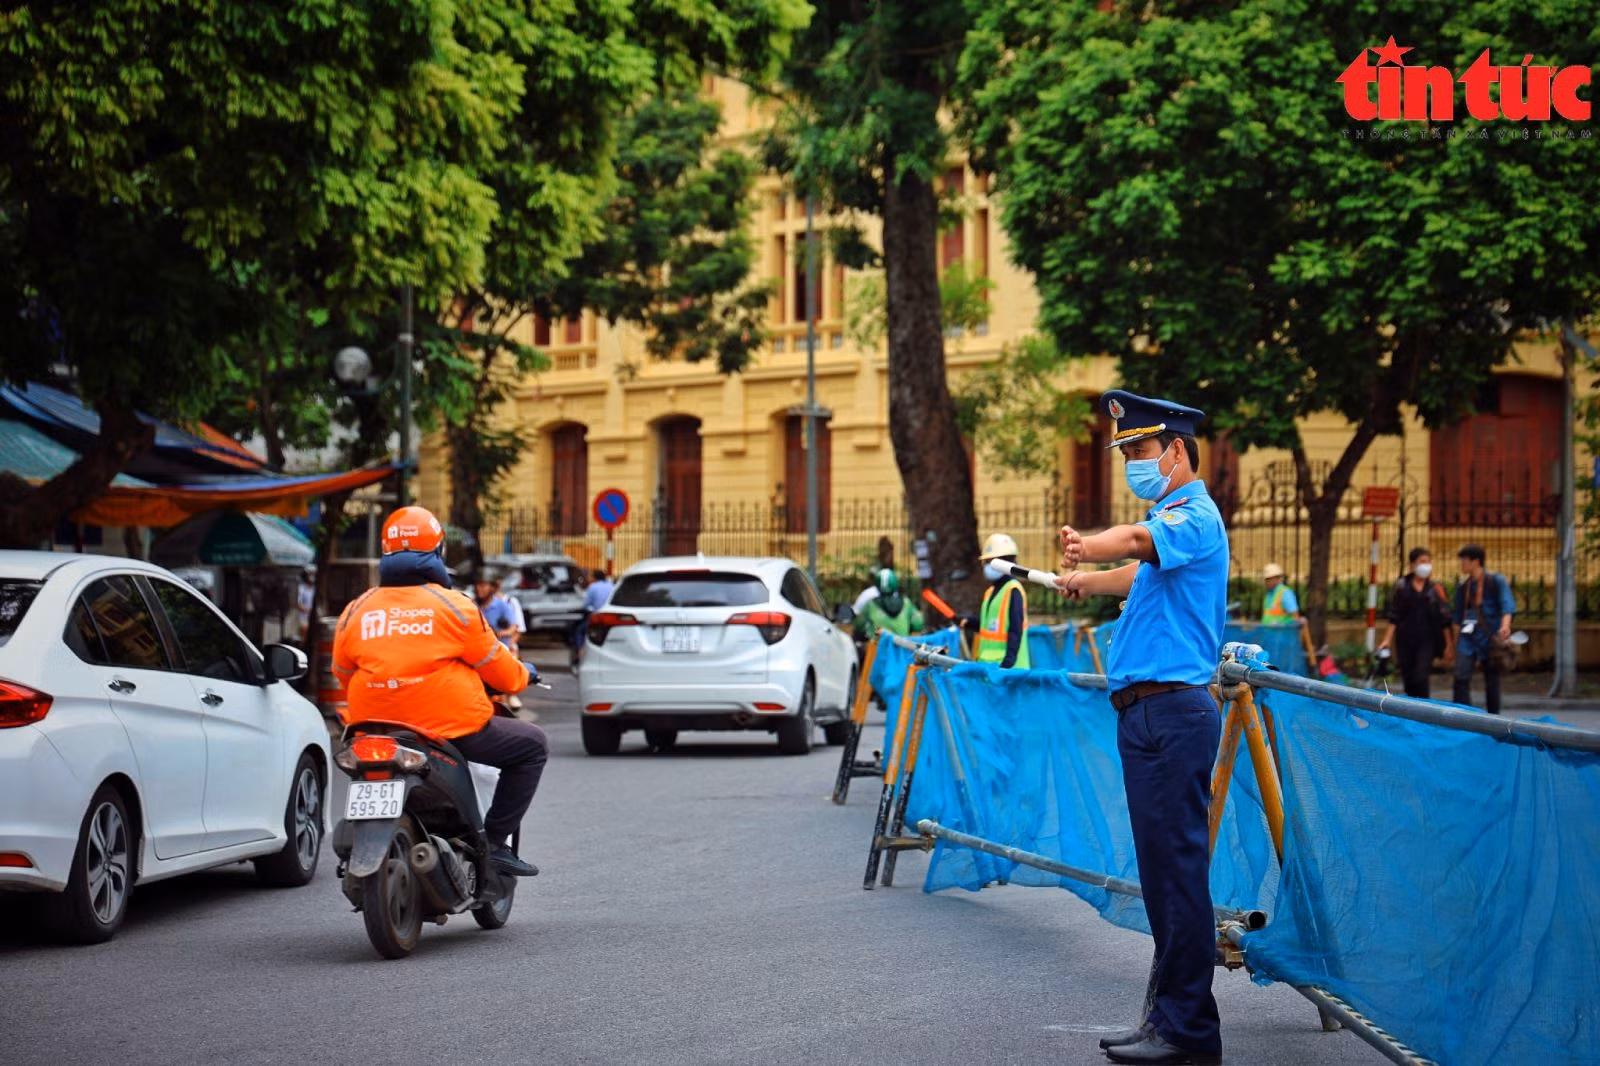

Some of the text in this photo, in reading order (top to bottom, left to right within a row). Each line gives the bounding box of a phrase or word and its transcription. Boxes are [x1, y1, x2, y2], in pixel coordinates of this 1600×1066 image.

[389, 607, 434, 620] Shopee
[387, 619, 433, 636] Food
[357, 783, 396, 800] 29-G1
[349, 800, 398, 817] 595.20
